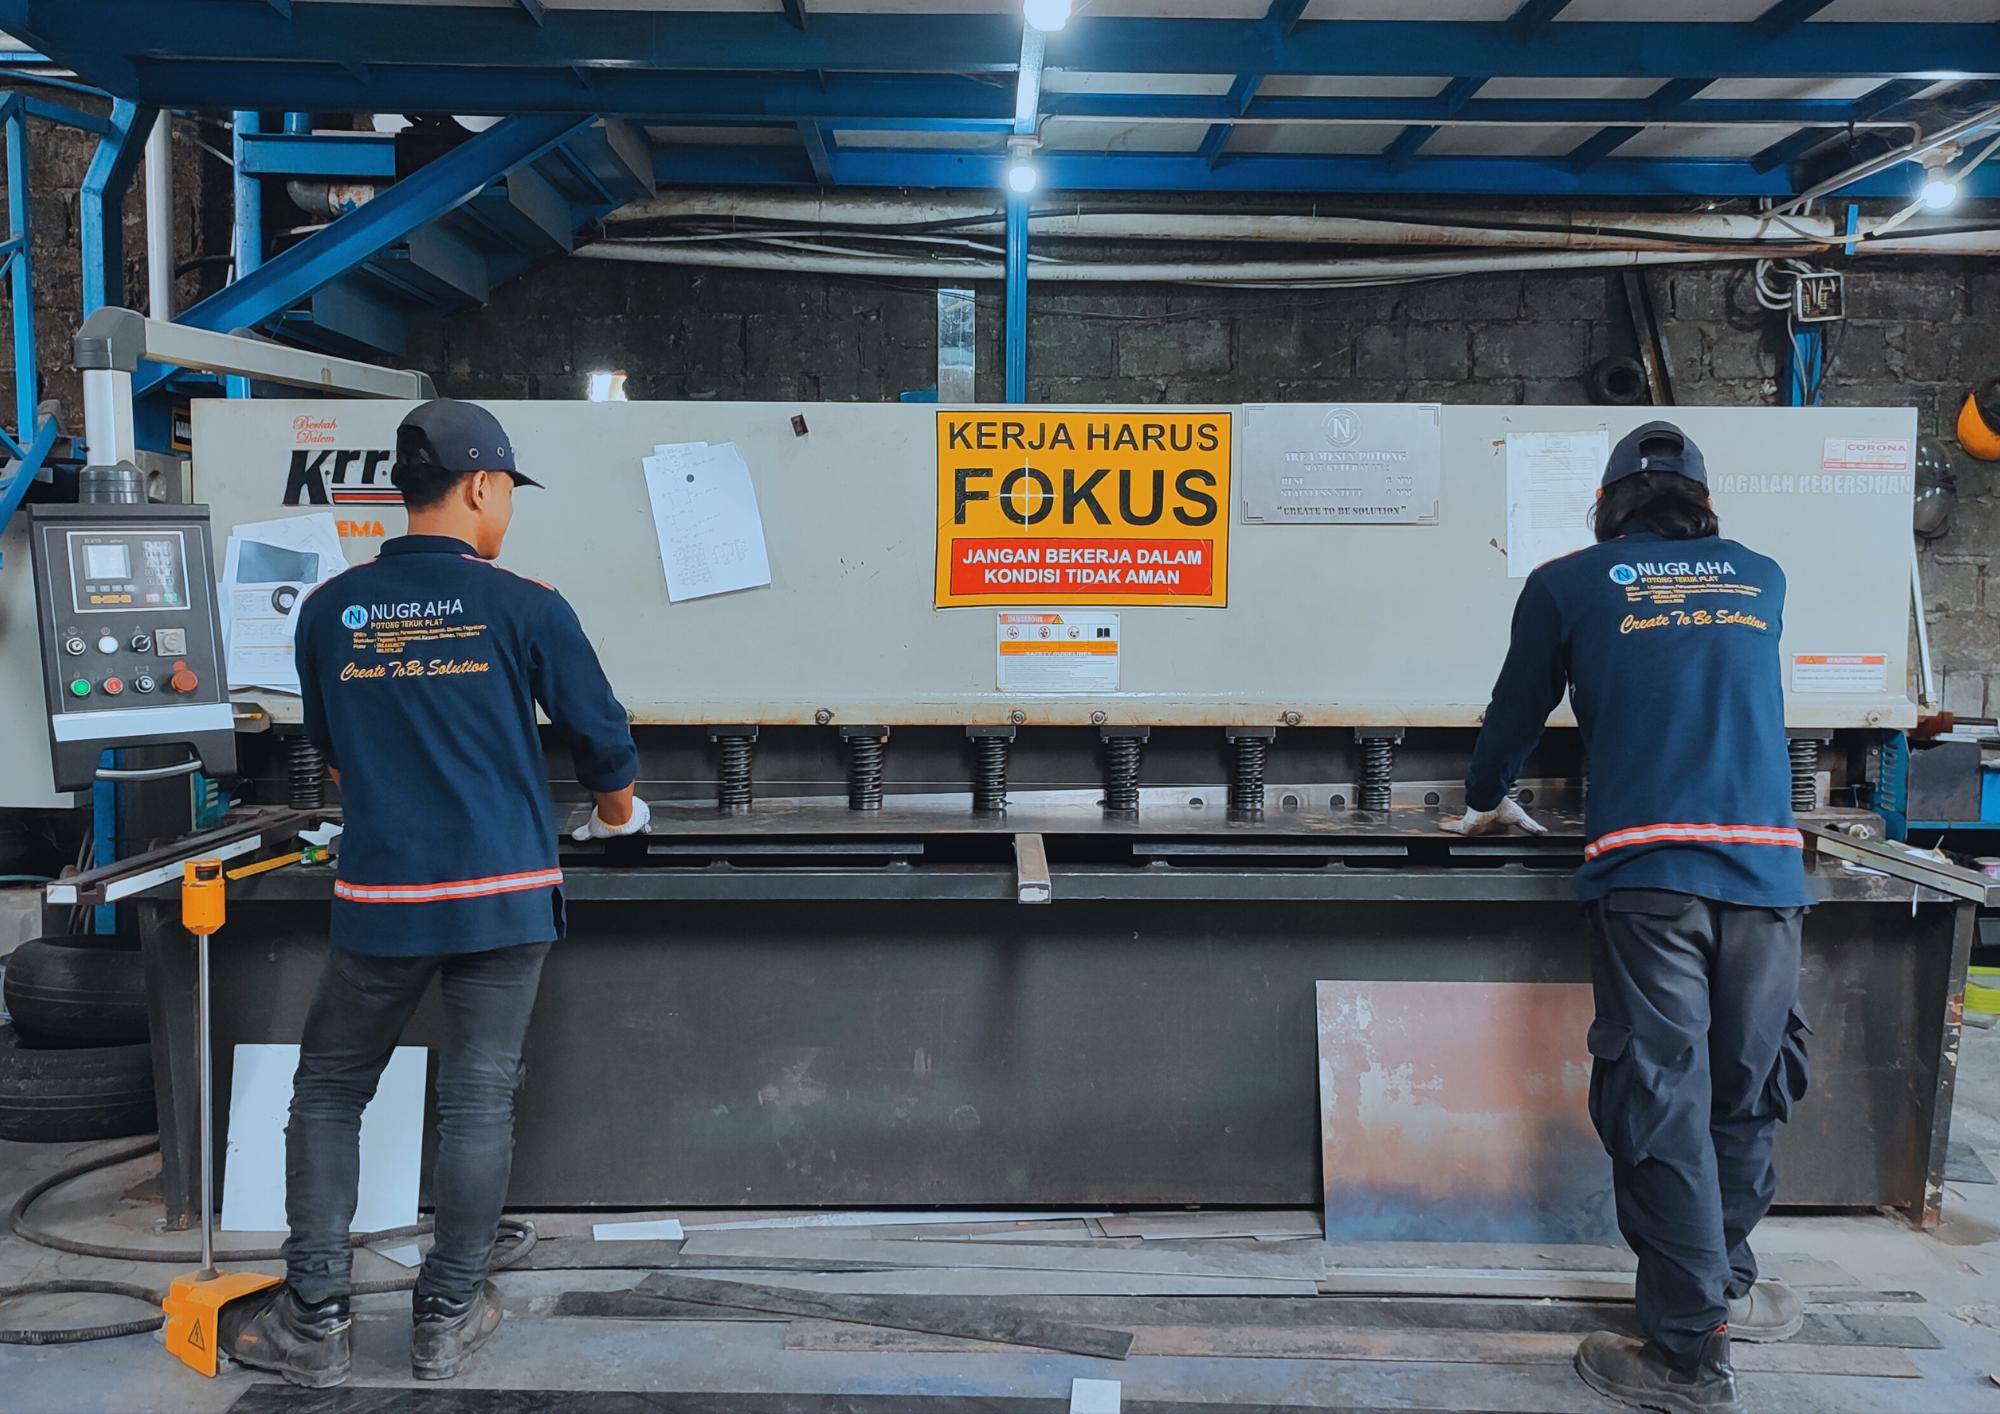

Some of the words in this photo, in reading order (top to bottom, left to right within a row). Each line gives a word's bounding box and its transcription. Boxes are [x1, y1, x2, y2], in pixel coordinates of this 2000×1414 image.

[292, 415, 338, 430] Berkah
[295, 429, 336, 443] Dalem
[949, 421, 1075, 450] KERJA
[1087, 423, 1219, 451] HARUS
[1847, 444, 1906, 452] CORONA
[1282, 451, 1314, 461] AREA
[1318, 451, 1355, 461] MESIN
[1359, 451, 1406, 461] POTONG
[1716, 474, 1794, 494] JAGALAH
[1798, 474, 1911, 494] KEBERSIHAN
[954, 467, 1218, 526] FOKUS
[1322, 507, 1335, 515] TO
[1338, 507, 1351, 515] BE
[962, 548, 1040, 565] JANGAN
[1045, 549, 1132, 565] BEKERJA
[1137, 550, 1202, 565] DALAM
[984, 568, 1061, 584] KONDISI
[1065, 569, 1122, 584] TIDAK
[1125, 570, 1180, 584] AMAN
[1636, 561, 1737, 576] NUGRAHA
[1641, 576, 1673, 584] POTONG
[349, 610, 361, 624] N
[371, 599, 464, 620] NUGRAHA
[1007, 615, 1044, 623] DANGEROUS
[370, 621, 400, 630] POTONG
[400, 619, 424, 629] TEKUK
[424, 618, 444, 627] PLAT
[1620, 614, 1670, 635] Create
[1670, 610, 1691, 626] To
[1691, 609, 1713, 625] Be
[1715, 609, 1768, 631] Solution
[340, 661, 386, 682] Create
[426, 658, 490, 676] Solution
